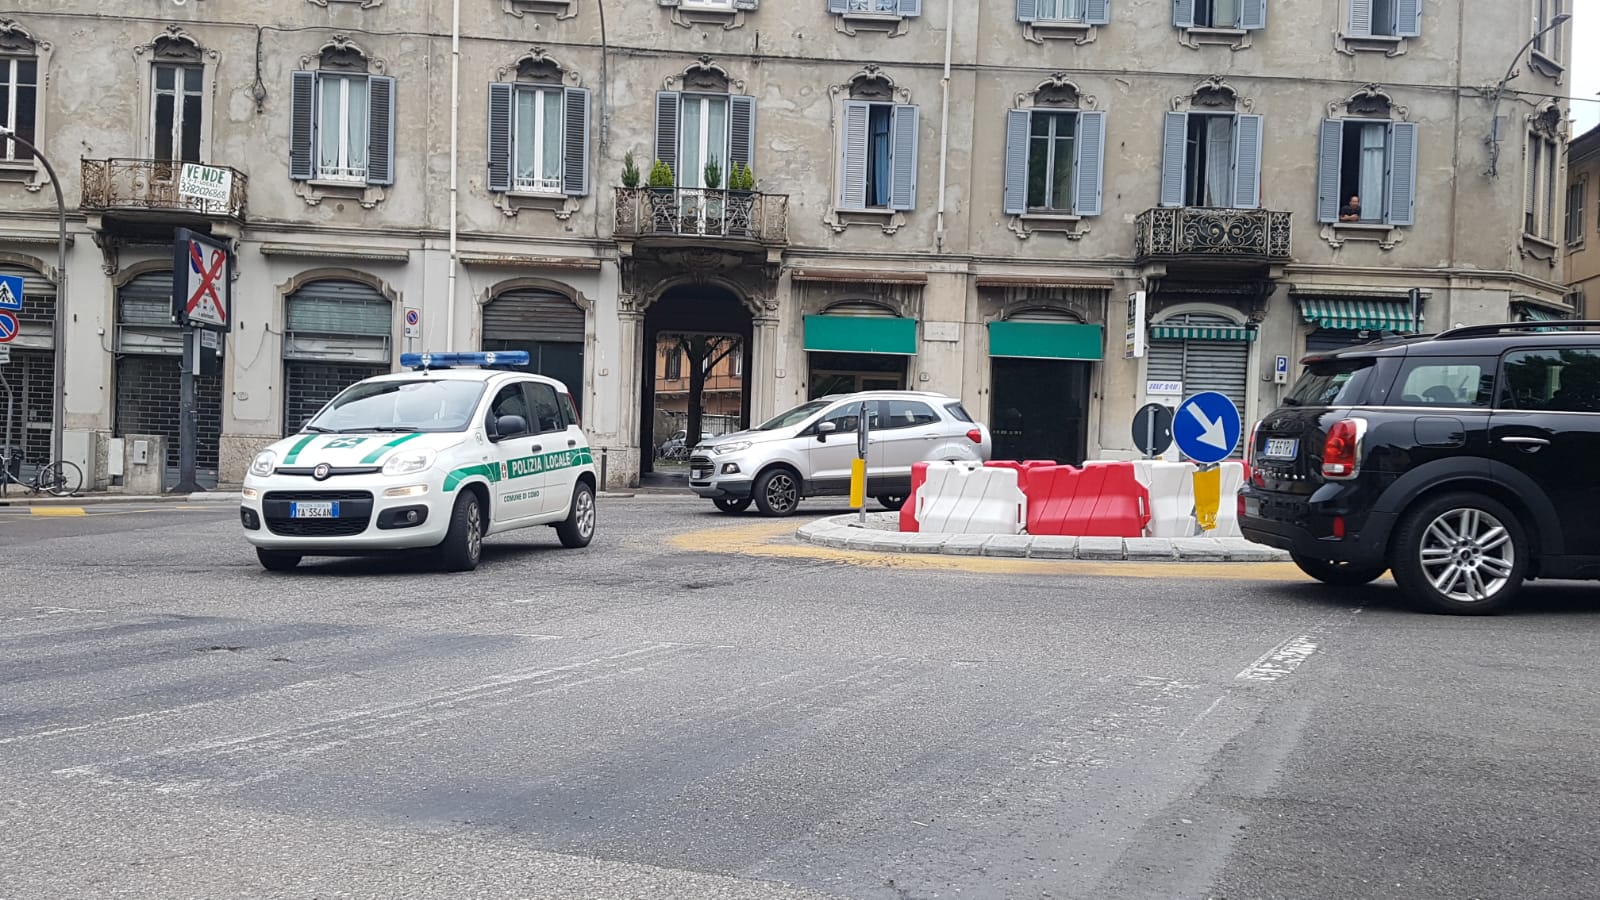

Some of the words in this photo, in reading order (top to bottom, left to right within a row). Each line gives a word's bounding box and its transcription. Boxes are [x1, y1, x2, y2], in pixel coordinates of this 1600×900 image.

[187, 165, 225, 184] VENDE
[1278, 358, 1285, 370] P
[512, 458, 542, 475] POLIZIA
[545, 452, 571, 469] LOCALE
[504, 493, 522, 503] COMUNE
[528, 490, 540, 499] COMO
